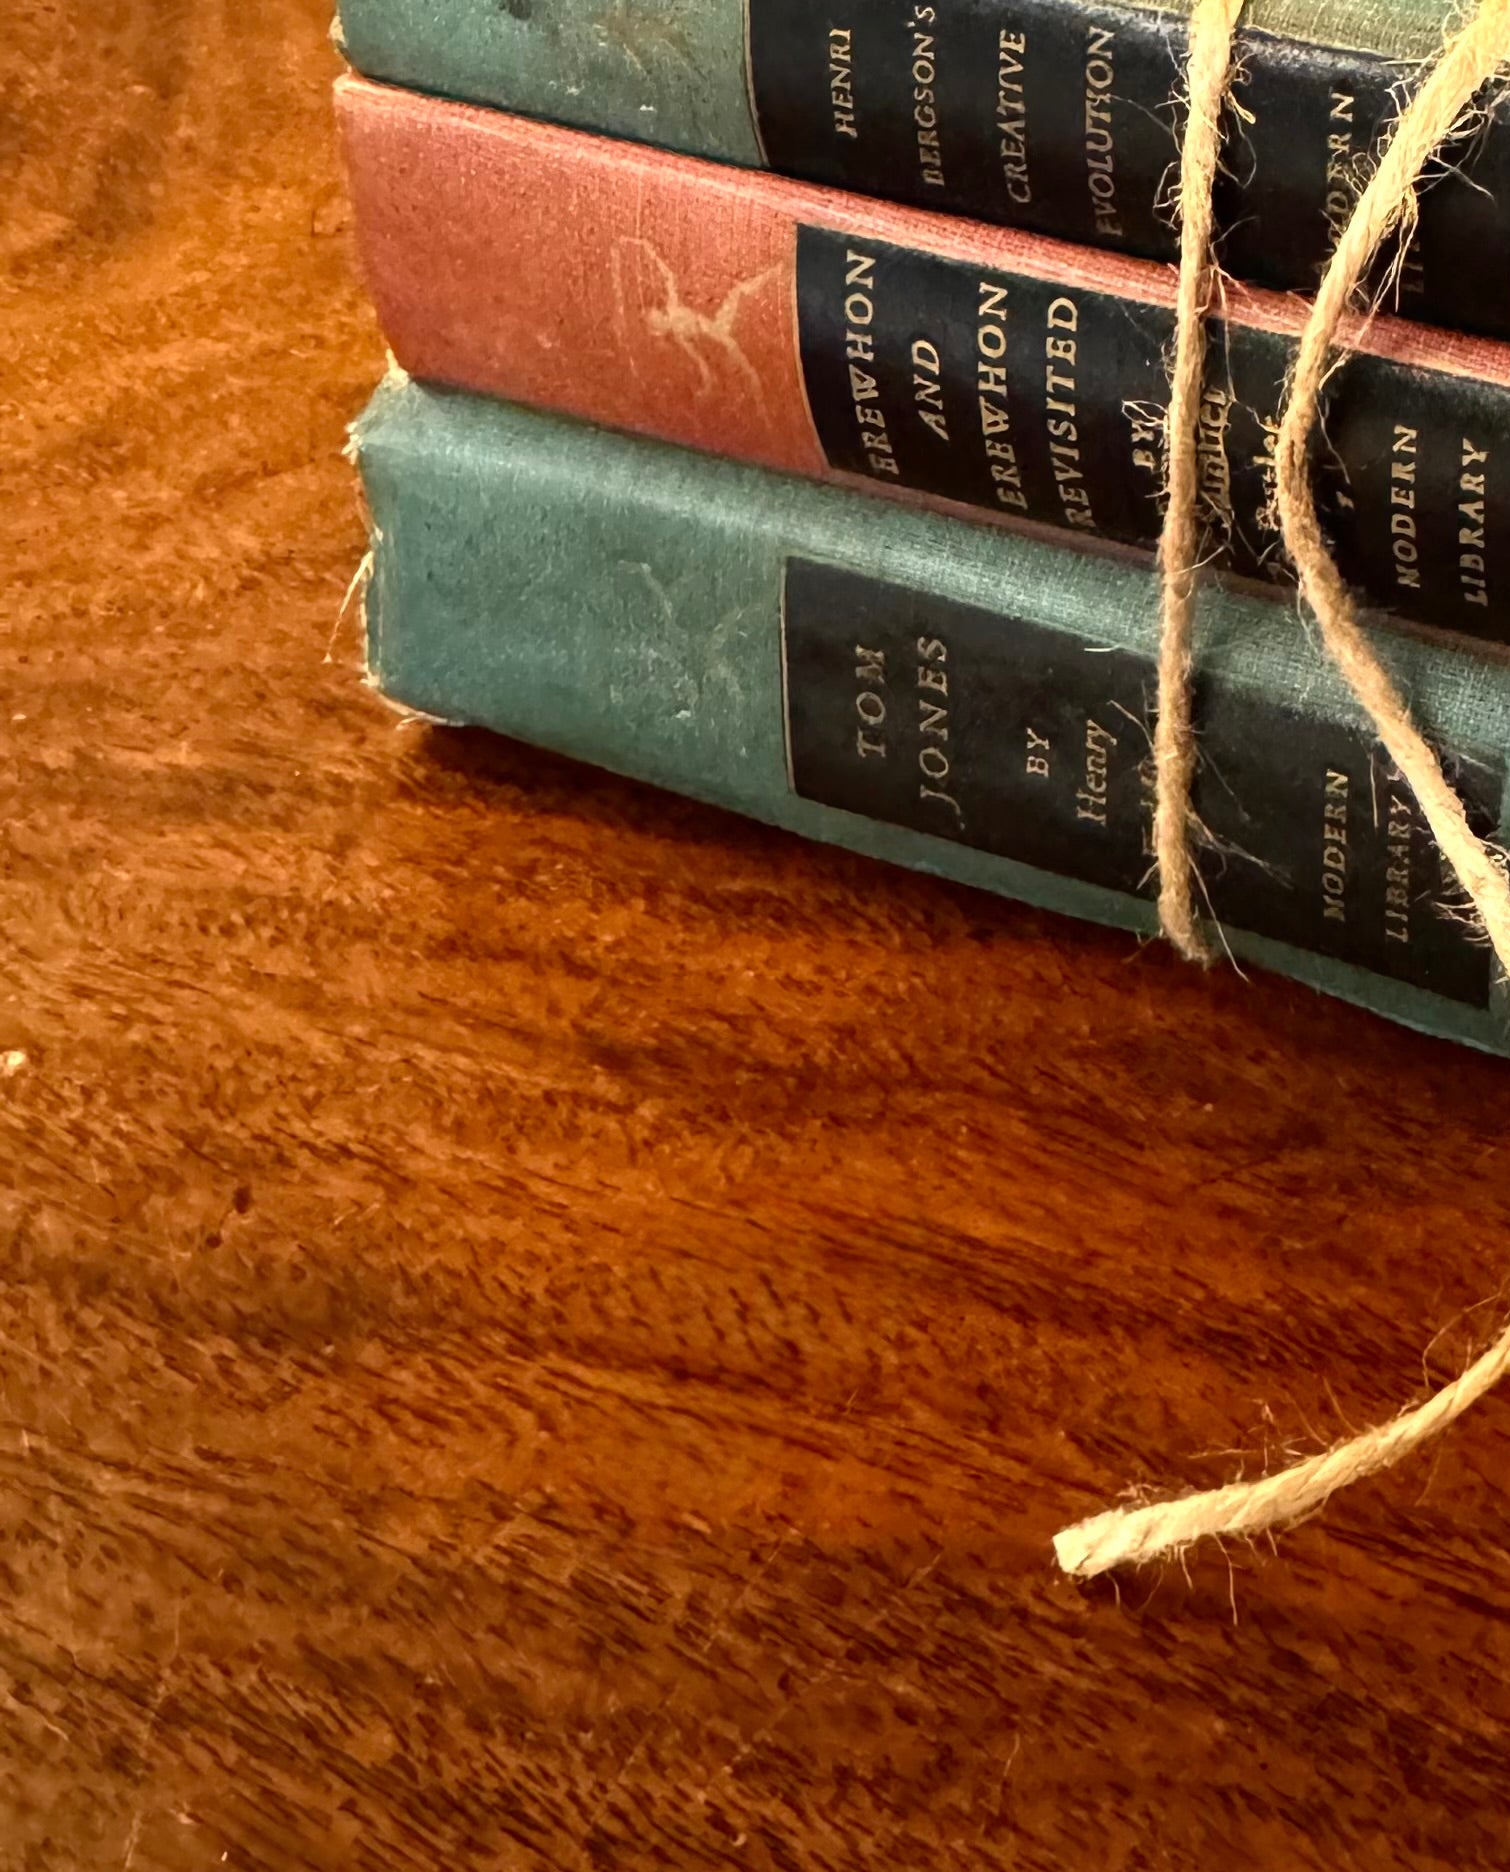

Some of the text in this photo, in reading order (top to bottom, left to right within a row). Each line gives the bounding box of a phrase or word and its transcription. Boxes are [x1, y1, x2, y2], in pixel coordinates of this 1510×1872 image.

[829, 27, 858, 140] HENRI
[907, 3, 946, 188] BERGSON'S
[997, 28, 1032, 205] CREATIVE
[1084, 25, 1125, 238] EVOLUTION
[846, 249, 899, 476] EREWHON
[911, 338, 950, 441] AND
[977, 282, 1029, 511] EREWHON
[1046, 296, 1098, 528] REVISITED
[1131, 422, 1157, 473] BY
[1391, 425, 1422, 589] MODERN
[1458, 437, 1492, 607] LIBRARY
[855, 643, 887, 759] TOM
[917, 634, 965, 830] JONES
[1026, 727, 1051, 779] BY
[1075, 719, 1118, 826] Henry
[1321, 768, 1349, 923] MODERN
[1385, 794, 1411, 943] LIBRARY
